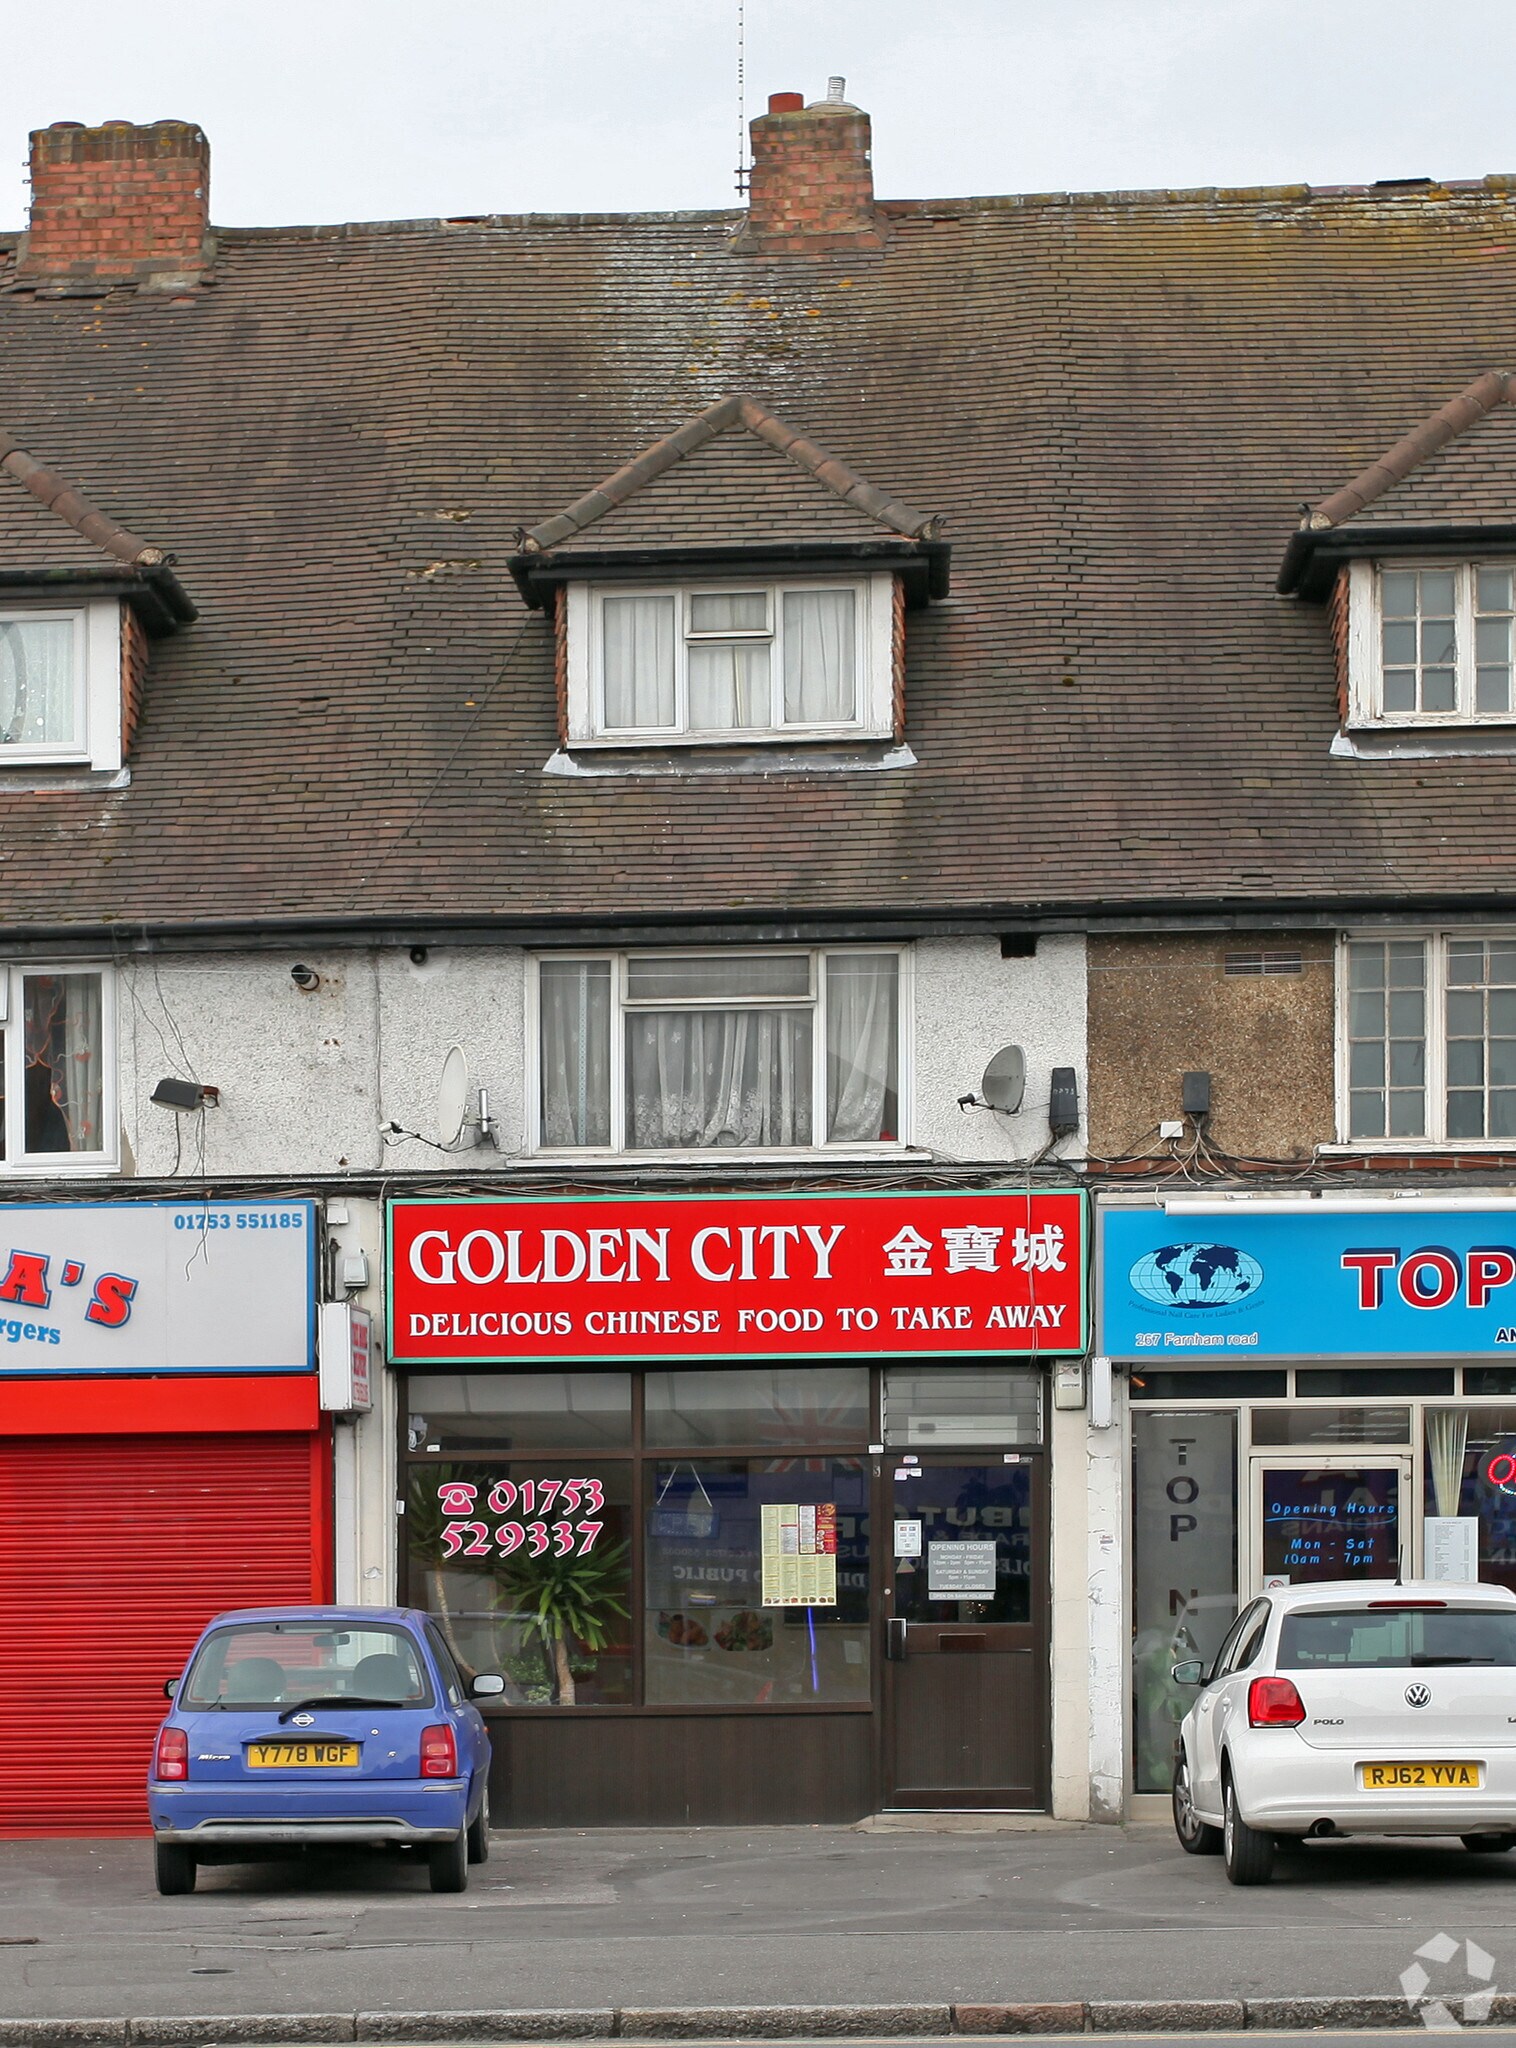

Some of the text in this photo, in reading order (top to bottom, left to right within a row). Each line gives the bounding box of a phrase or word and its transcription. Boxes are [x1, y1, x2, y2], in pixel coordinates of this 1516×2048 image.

[174, 1212, 303, 1230] 01753 551185
[409, 1224, 847, 1285] GOLDEN CITY
[882, 1224, 1067, 1277] 金寶城
[1341, 1245, 1516, 1310] TOP
[1128, 1300, 1167, 1316] Professional
[1168, 1310, 1183, 1318] Nail
[1215, 1309, 1236, 1318] Ladies
[409, 1304, 1067, 1337] DELICIOUS CHINESE FOOD TO TAKE AWAY
[1136, 1331, 1258, 1346] 267 Farnham road
[487, 1478, 605, 1516] 01753
[1271, 1502, 1395, 1517] Opening Hours
[440, 1519, 604, 1559] 529337
[966, 1543, 994, 1551] HOURS
[1290, 1538, 1321, 1550] Mon
[1346, 1538, 1375, 1550] Sat
[1284, 1553, 1320, 1564] 10am
[1344, 1552, 1373, 1565] 7pm
[1313, 1718, 1345, 1726] POLO
[257, 1745, 352, 1763] Y778 WGF
[1372, 1766, 1471, 1786] RJ62 YVA
